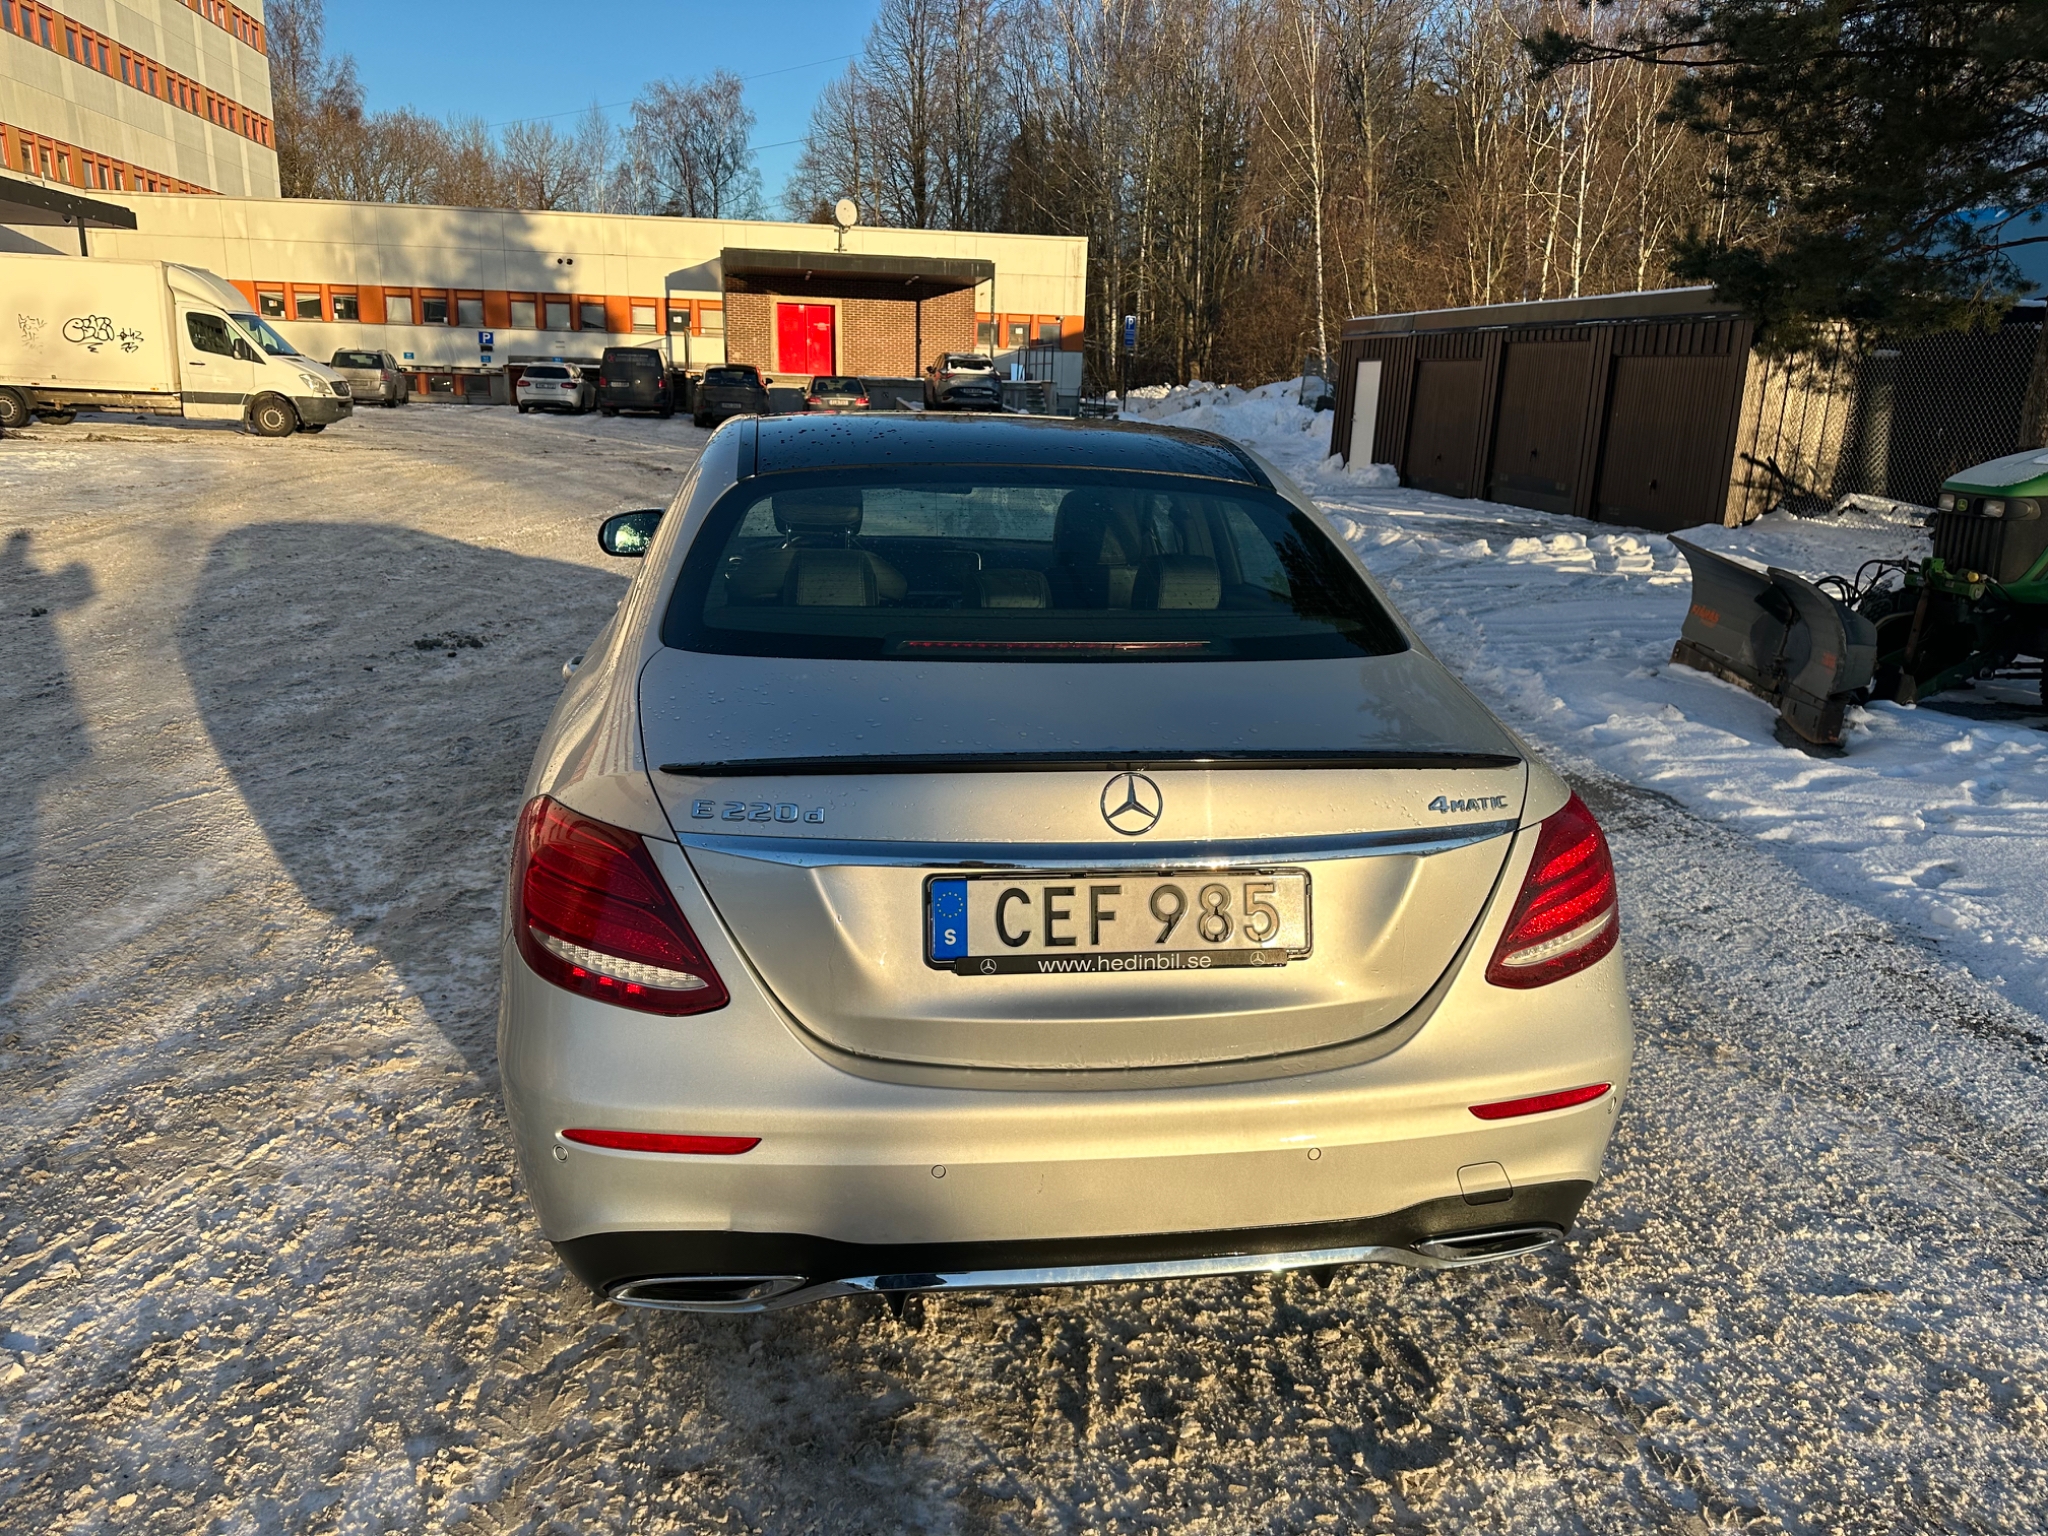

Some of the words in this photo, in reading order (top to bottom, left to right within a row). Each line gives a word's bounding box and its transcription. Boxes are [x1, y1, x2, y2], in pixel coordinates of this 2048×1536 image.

[483, 332, 491, 343] P
[691, 799, 716, 819] E
[1428, 795, 1508, 814] 4MATIC
[995, 885, 1122, 948] CEF
[1149, 881, 1281, 944] 985
[944, 928, 957, 946] S
[1037, 953, 1213, 973] www.hedinbil.se
